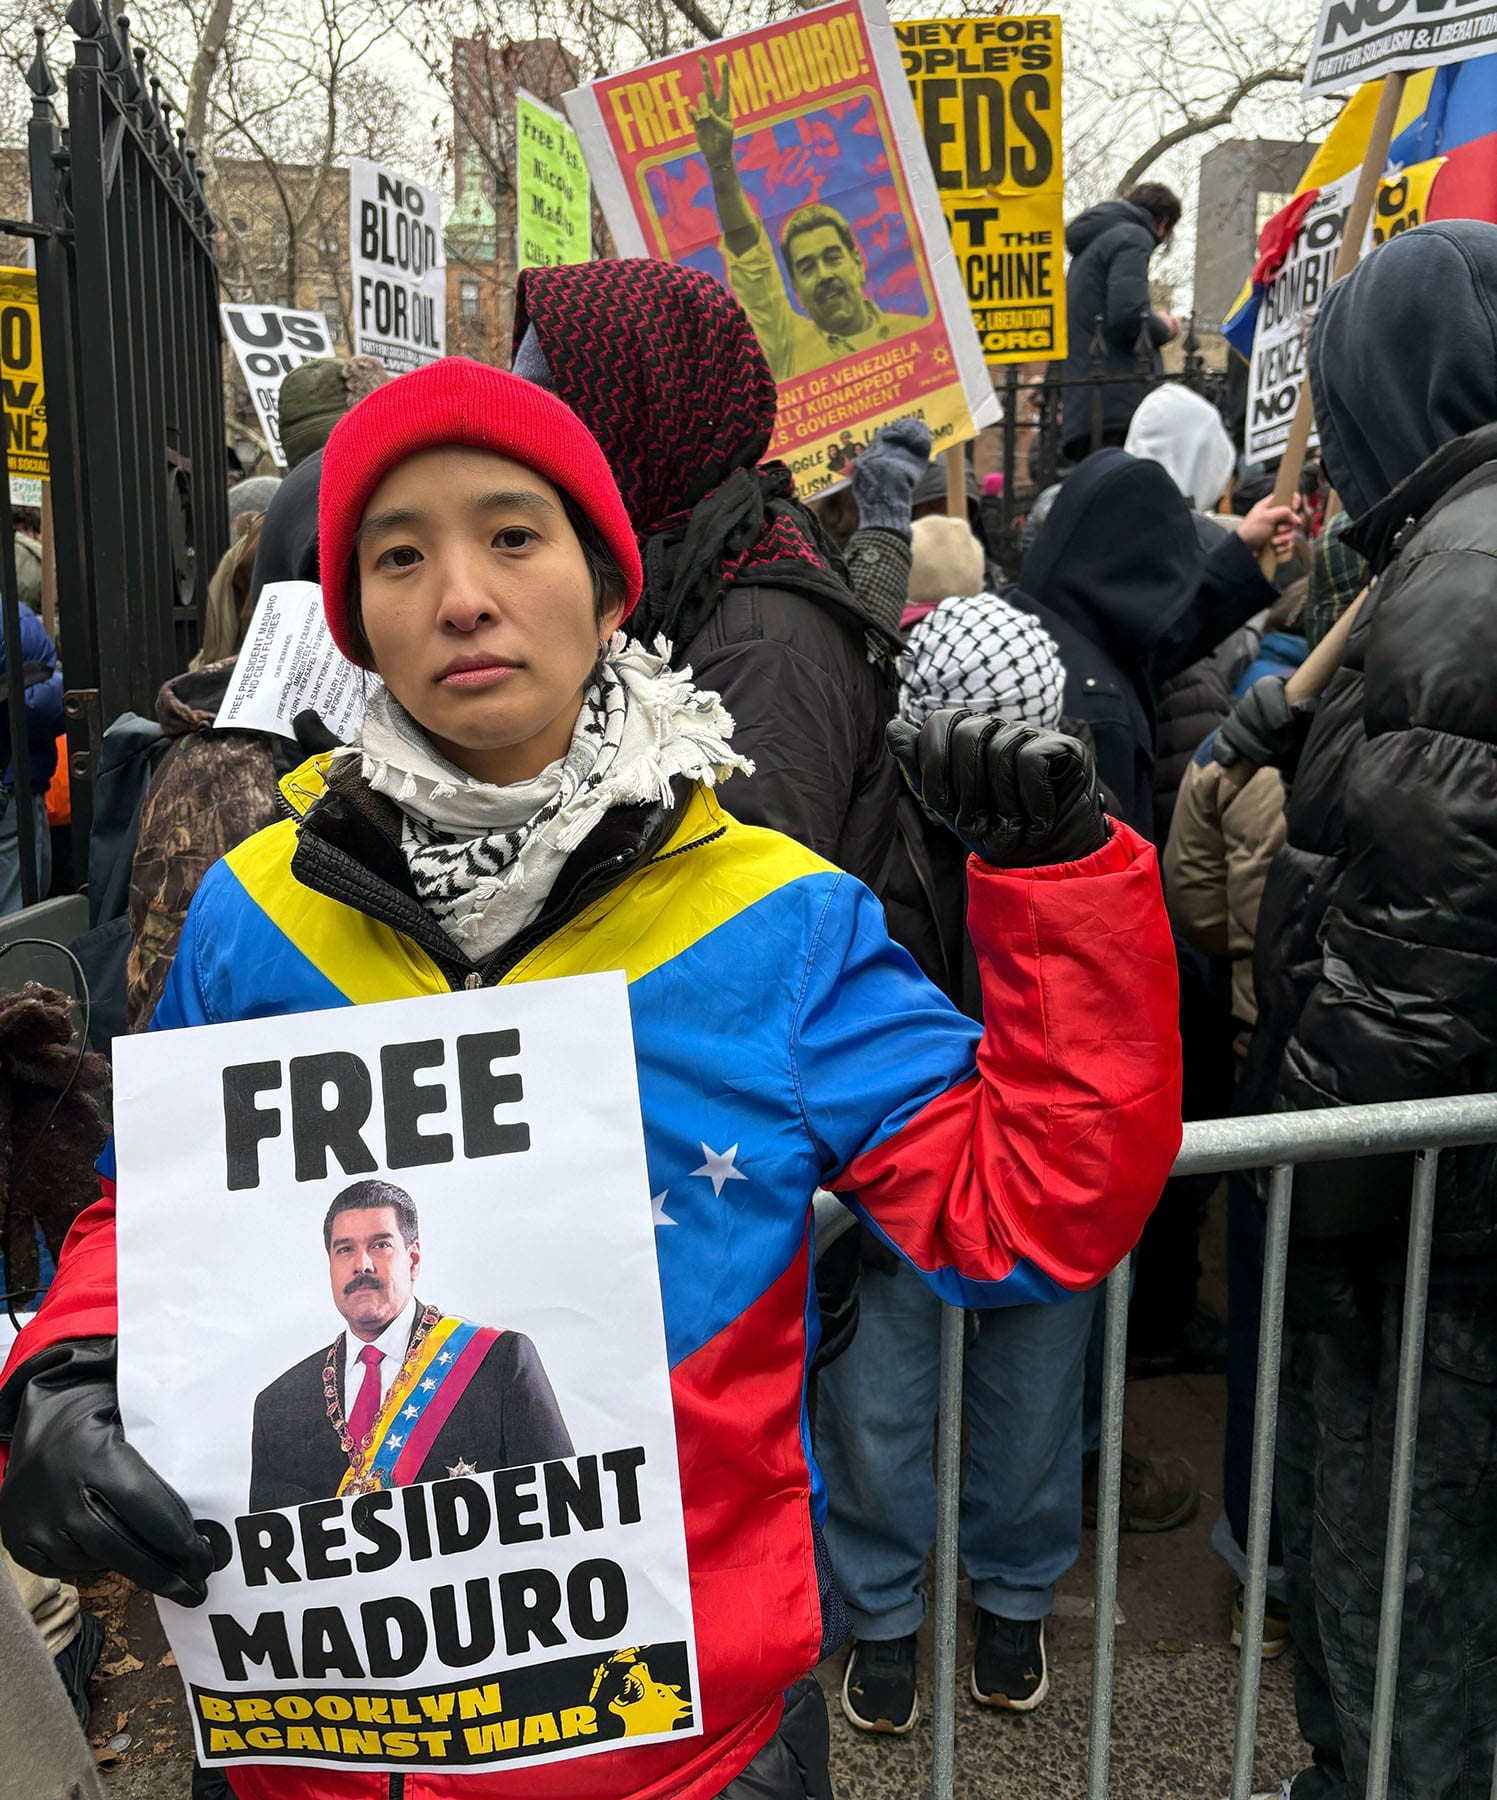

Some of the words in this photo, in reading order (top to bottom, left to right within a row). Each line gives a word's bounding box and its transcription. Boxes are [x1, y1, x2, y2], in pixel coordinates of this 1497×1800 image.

[894, 23, 966, 46] NEY
[974, 20, 1052, 44] FOR
[1313, 56, 1343, 80] PARTY
[1361, 29, 1415, 65] SOCIALISM
[1412, 28, 1431, 50] &
[1431, 13, 1497, 47] LIBERATION
[608, 70, 695, 153] FREE
[715, 12, 870, 119] MADURO!
[901, 44, 1053, 76] OPLE'S
[523, 114, 554, 151] Free
[908, 73, 1053, 190] EDS
[378, 172, 424, 217] NO
[361, 199, 437, 276] BLOOD
[999, 231, 1052, 247] THE
[957, 251, 1052, 303] CHINE
[1265, 248, 1338, 330] BOMBI
[227, 311, 325, 353] US
[360, 275, 408, 340] FOR
[412, 290, 439, 348] OIL
[986, 308, 1051, 329] LIBERATION
[980, 329, 1050, 352] .ORG
[806, 370, 894, 416] KIDNAPPED
[896, 361, 917, 380] BY
[808, 377, 829, 396] OF
[831, 341, 922, 380] VENEZUELA
[795, 384, 902, 438] GOVERNMENT
[1254, 383, 1302, 425] NO
[228, 695, 245, 720] FREE
[240, 636, 264, 694] PRESIDENT
[258, 594, 278, 635] MADURO
[246, 678, 260, 699] AND
[253, 651, 268, 680] CILIA
[262, 612, 281, 652] FLORES
[276, 701, 286, 720] FREE
[291, 645, 304, 672] MADURO
[300, 622, 310, 640] CILIA
[305, 600, 319, 624] FLORES
[296, 678, 308, 697] THEM
[304, 652, 318, 678] SAFELY
[312, 641, 321, 654] TO
[310, 659, 331, 701] SANCTIONS
[325, 650, 334, 662] ON
[328, 671, 351, 716] INFORMATION
[341, 710, 352, 724] THE
[222, 1028, 531, 1191] FREE
[209, 1558, 628, 1681] MADURO
[199, 1683, 502, 1725] BROOKLYN
[209, 1726, 453, 1758] AGAINST
[462, 1705, 598, 1756] WAR
